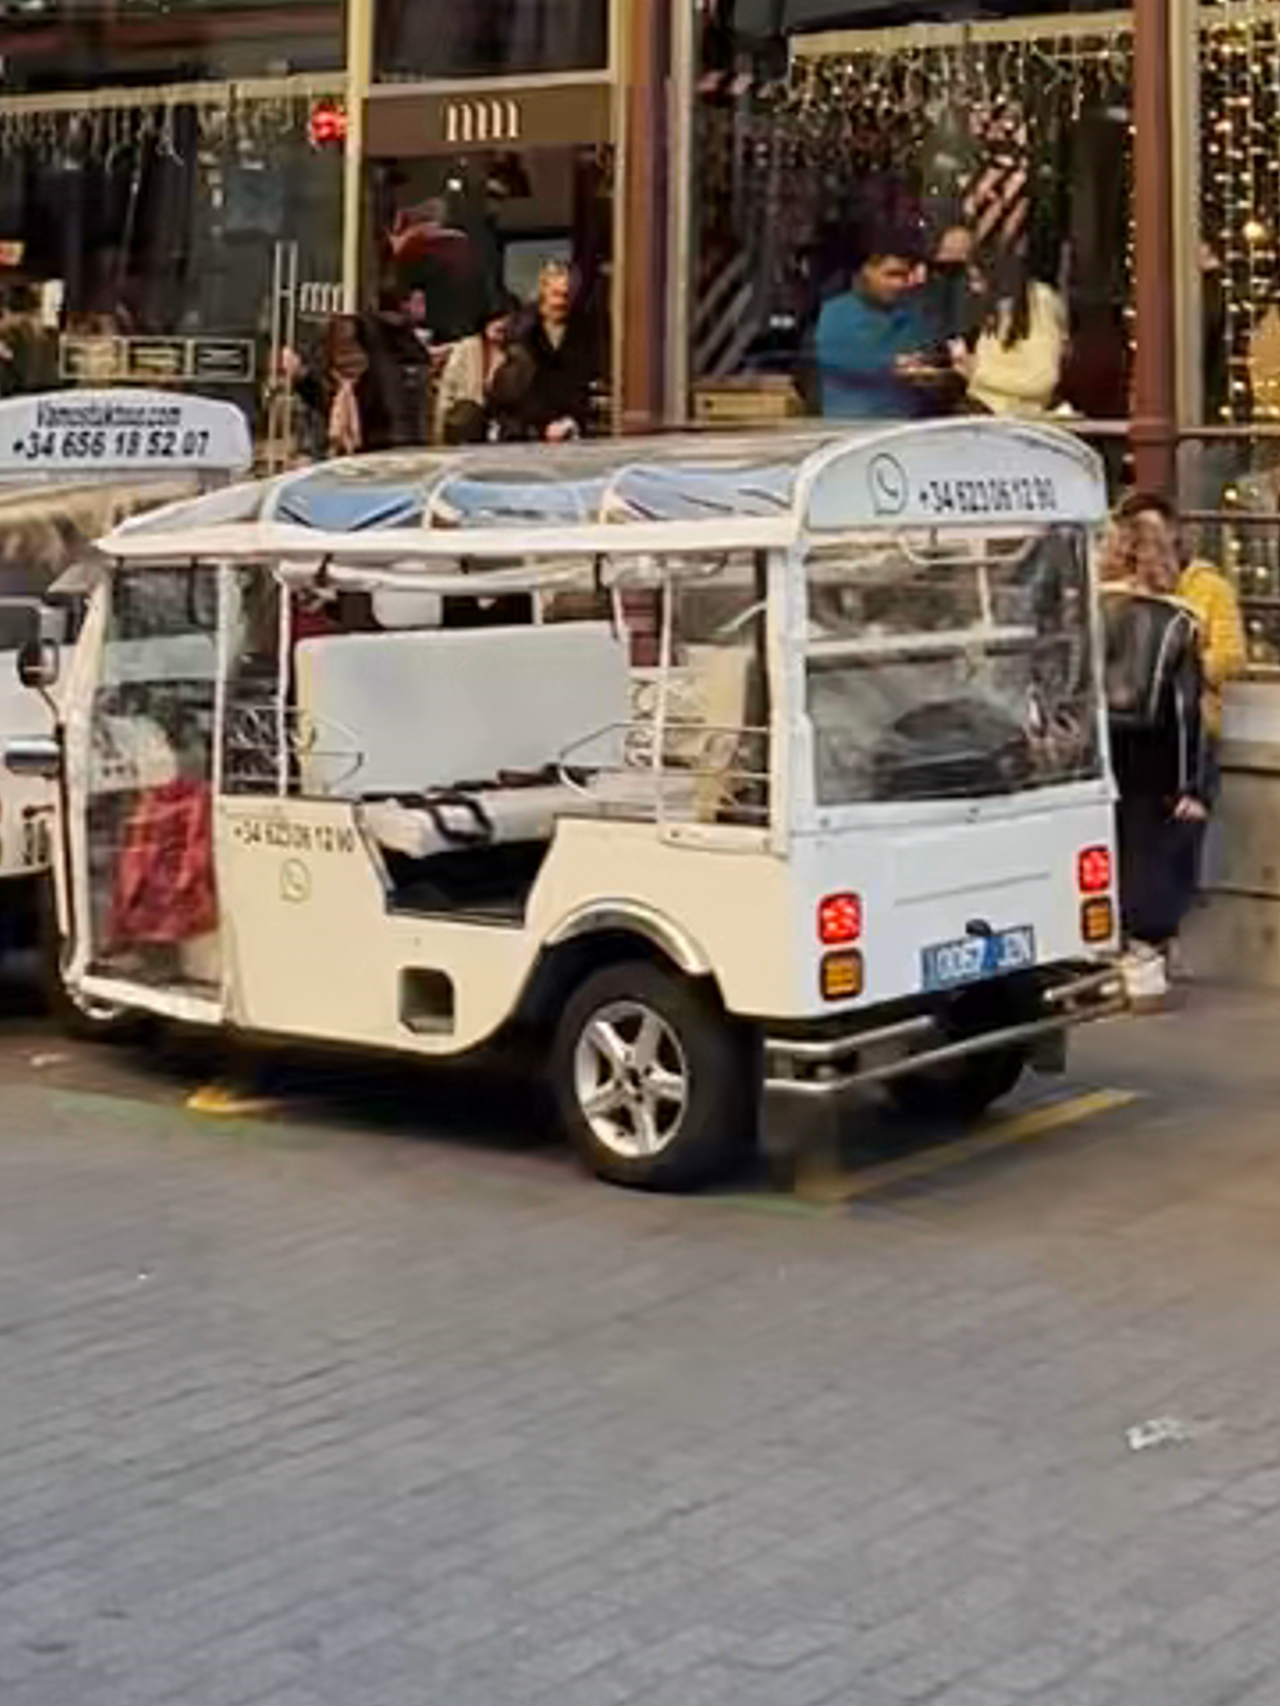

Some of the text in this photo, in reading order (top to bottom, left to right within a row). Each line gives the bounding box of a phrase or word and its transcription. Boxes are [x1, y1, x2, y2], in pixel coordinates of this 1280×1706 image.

[12, 430, 57, 461] +34
[61, 430, 106, 459] 656
[146, 430, 177, 458] 52
